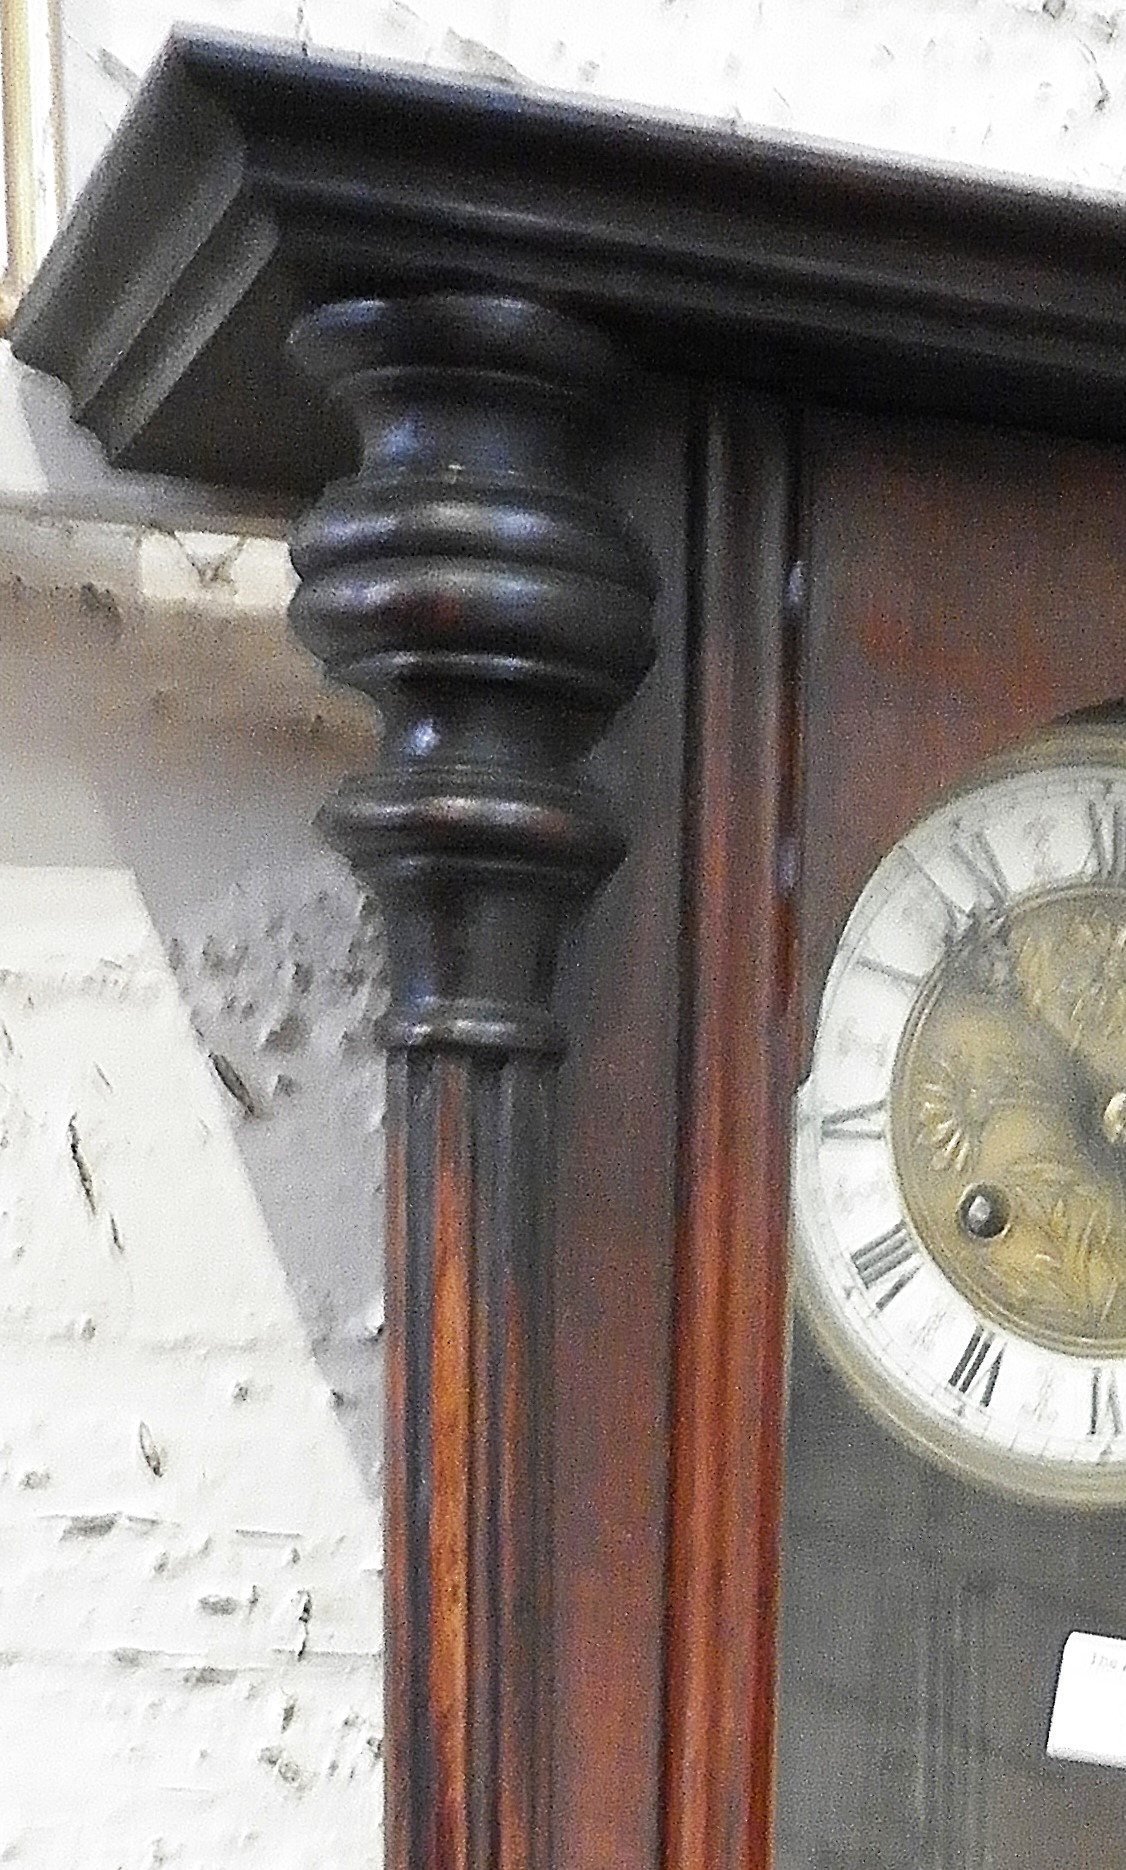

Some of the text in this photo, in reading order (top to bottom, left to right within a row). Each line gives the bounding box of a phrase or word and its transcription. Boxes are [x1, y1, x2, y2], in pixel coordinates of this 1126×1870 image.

[850, 1221, 924, 1312] VIII
[947, 1326, 1008, 1408] VII
[1088, 1366, 1123, 1437] VI
